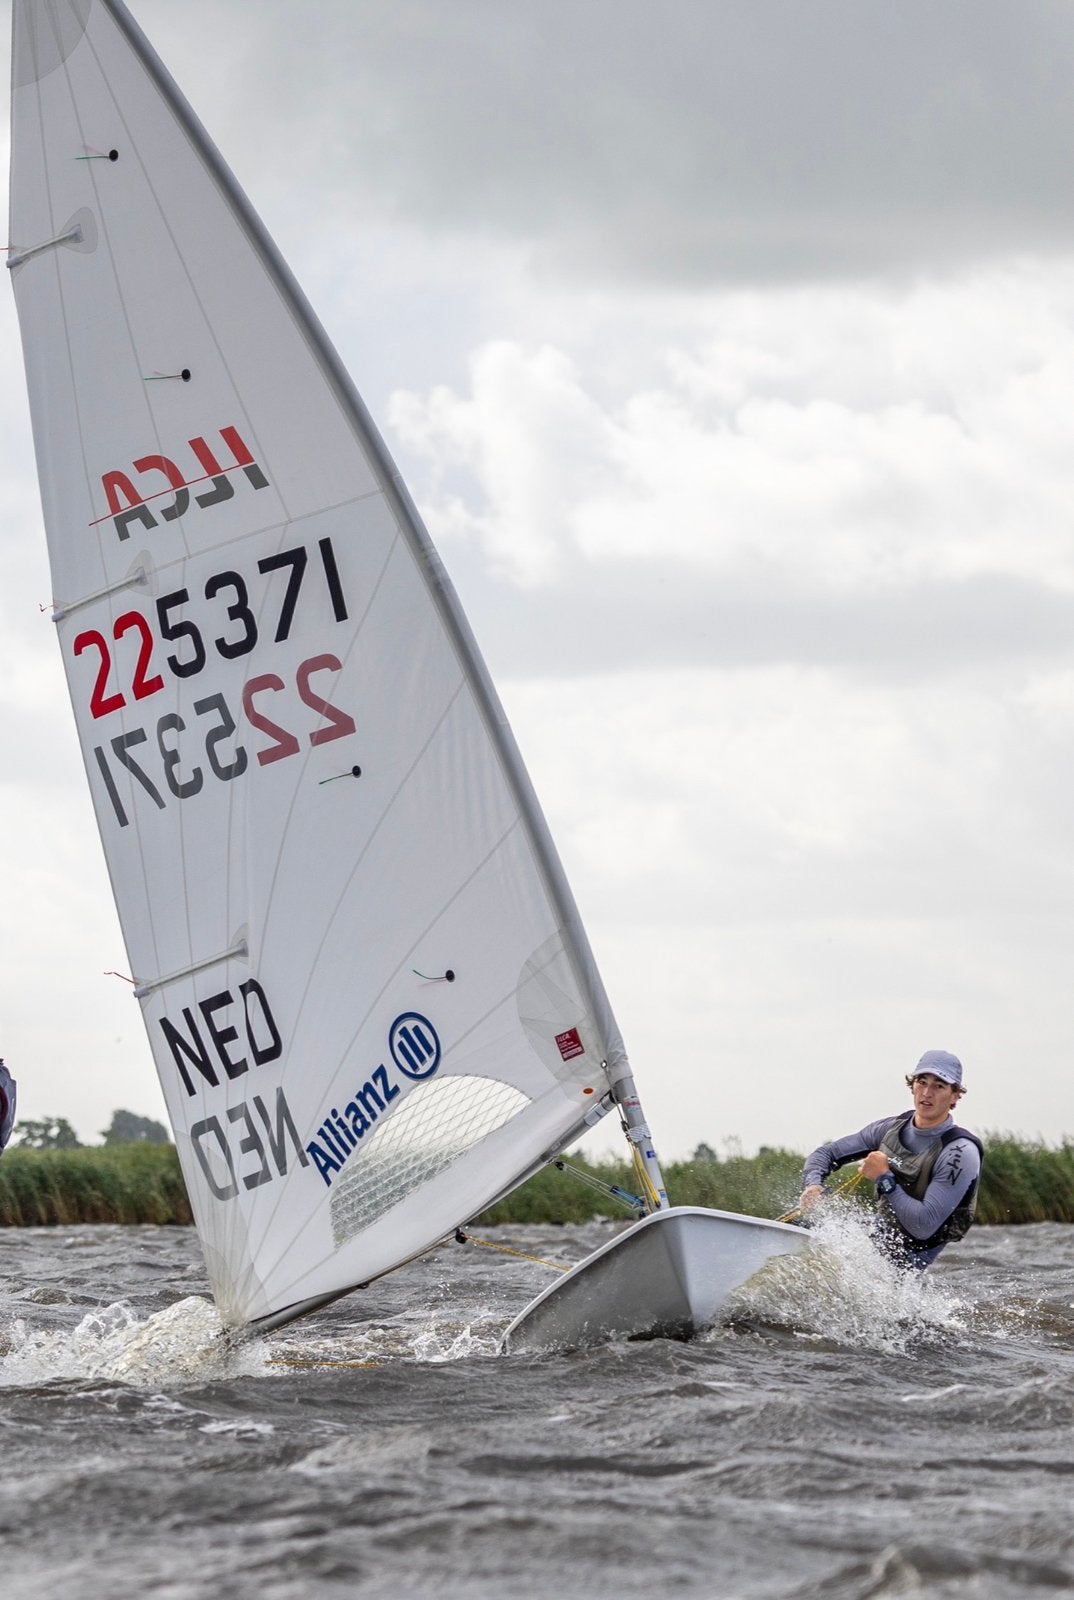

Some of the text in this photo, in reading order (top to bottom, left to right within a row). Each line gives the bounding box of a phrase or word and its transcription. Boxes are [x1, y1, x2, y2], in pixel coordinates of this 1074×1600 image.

[74, 536, 349, 719] 225371
[158, 978, 283, 1097] NED
[306, 1063, 401, 1187] Allianz
